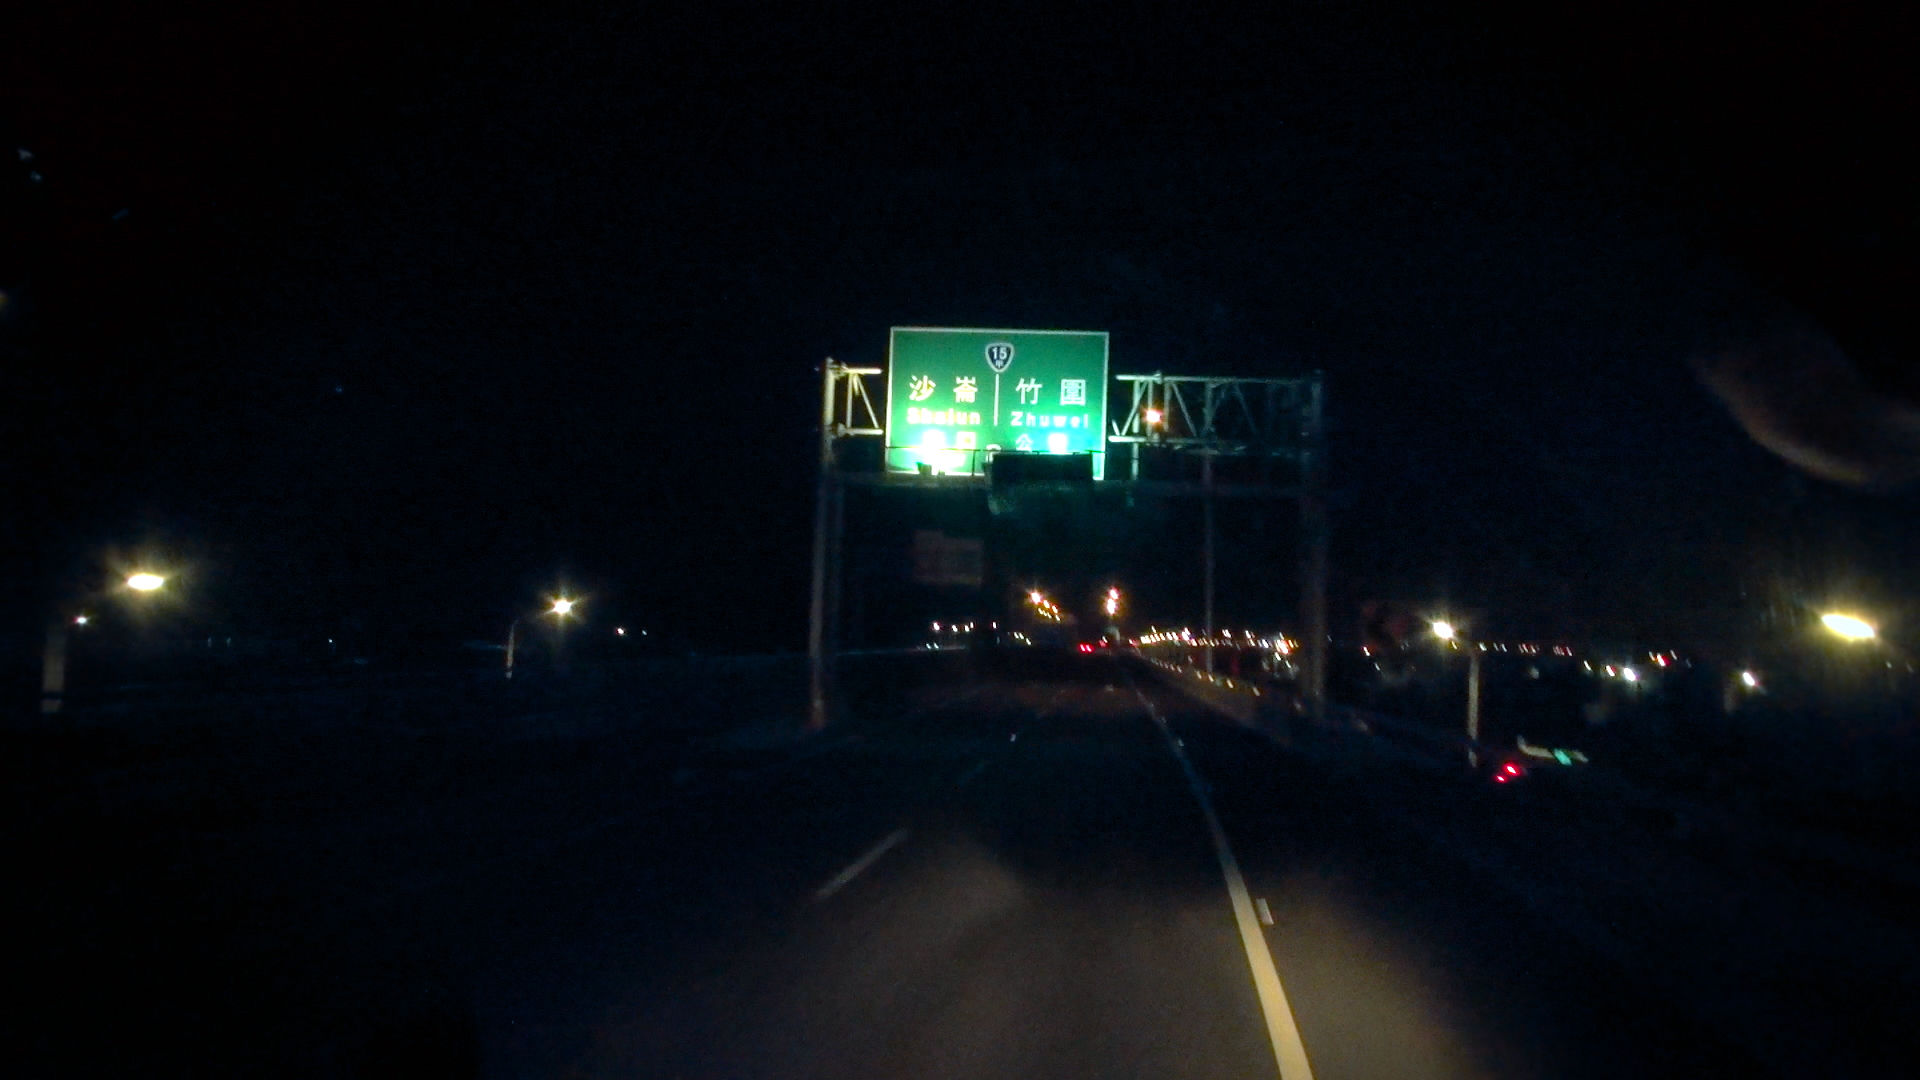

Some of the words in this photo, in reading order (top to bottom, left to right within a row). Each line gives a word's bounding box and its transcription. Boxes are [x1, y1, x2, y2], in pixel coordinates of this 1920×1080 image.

[992, 347, 1008, 360] 15
[1015, 378, 1087, 406] 竹圍
[907, 407, 981, 426] Shalun
[1010, 411, 1089, 428] Zhuwei
